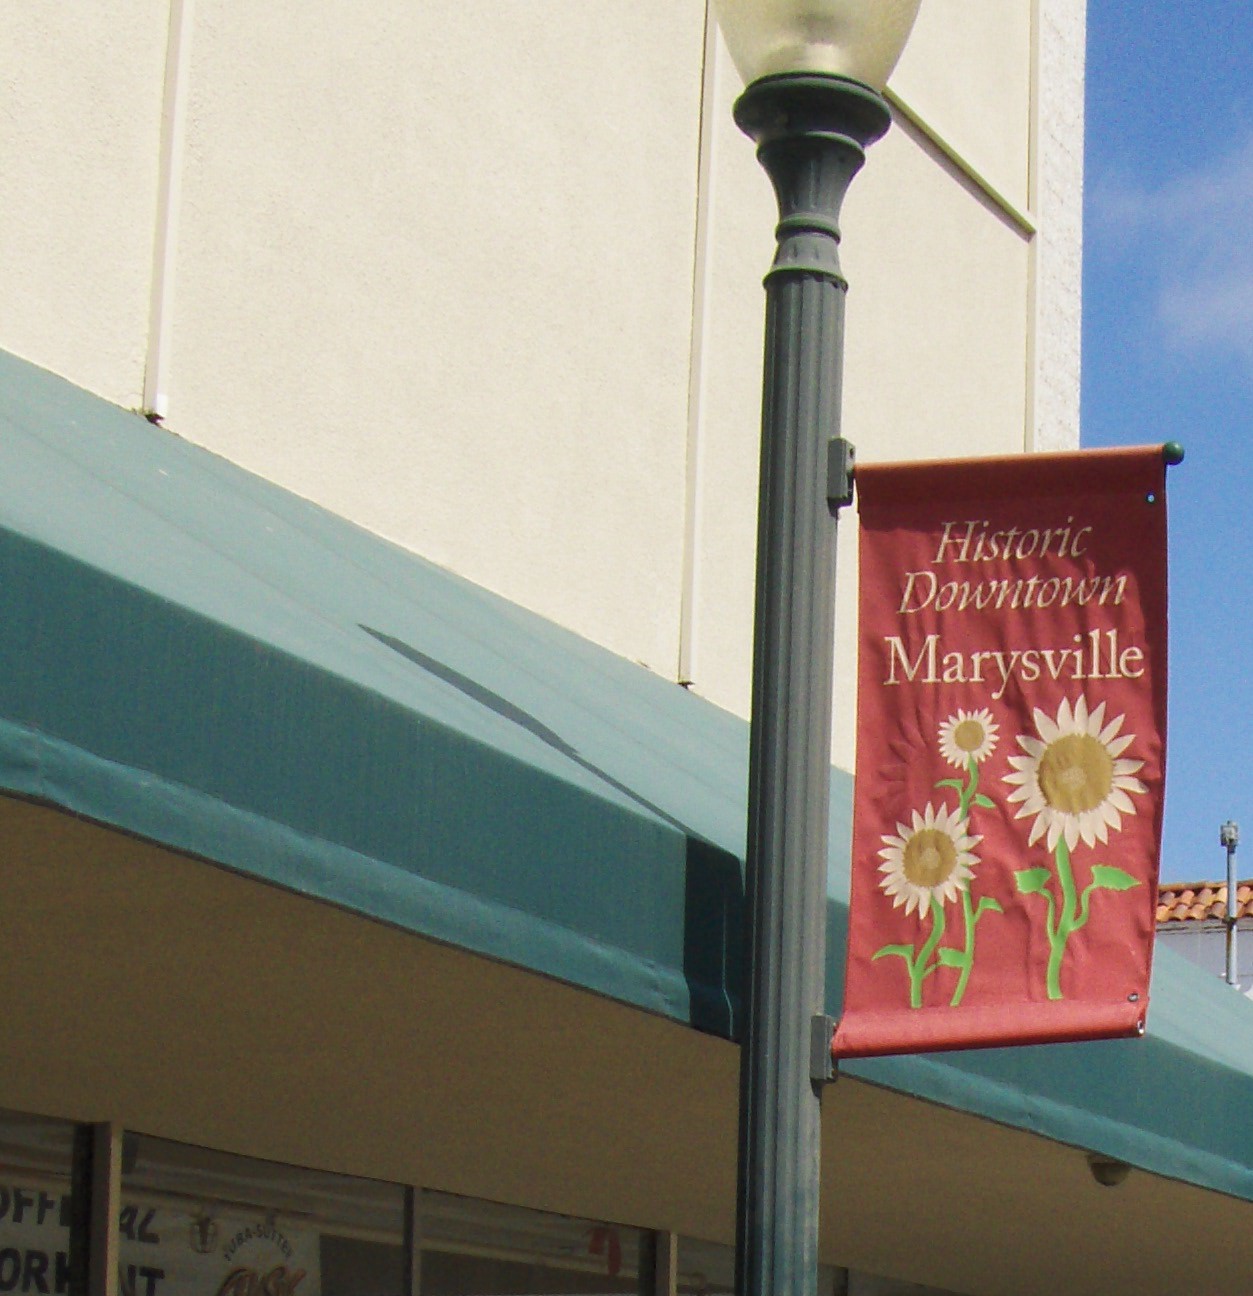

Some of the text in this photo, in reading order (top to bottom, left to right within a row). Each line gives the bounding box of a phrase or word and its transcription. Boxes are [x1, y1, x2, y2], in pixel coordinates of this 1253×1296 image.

[931, 516, 1093, 564] Historic
[896, 570, 1128, 614] Downtown
[883, 628, 1145, 700] Marysville
